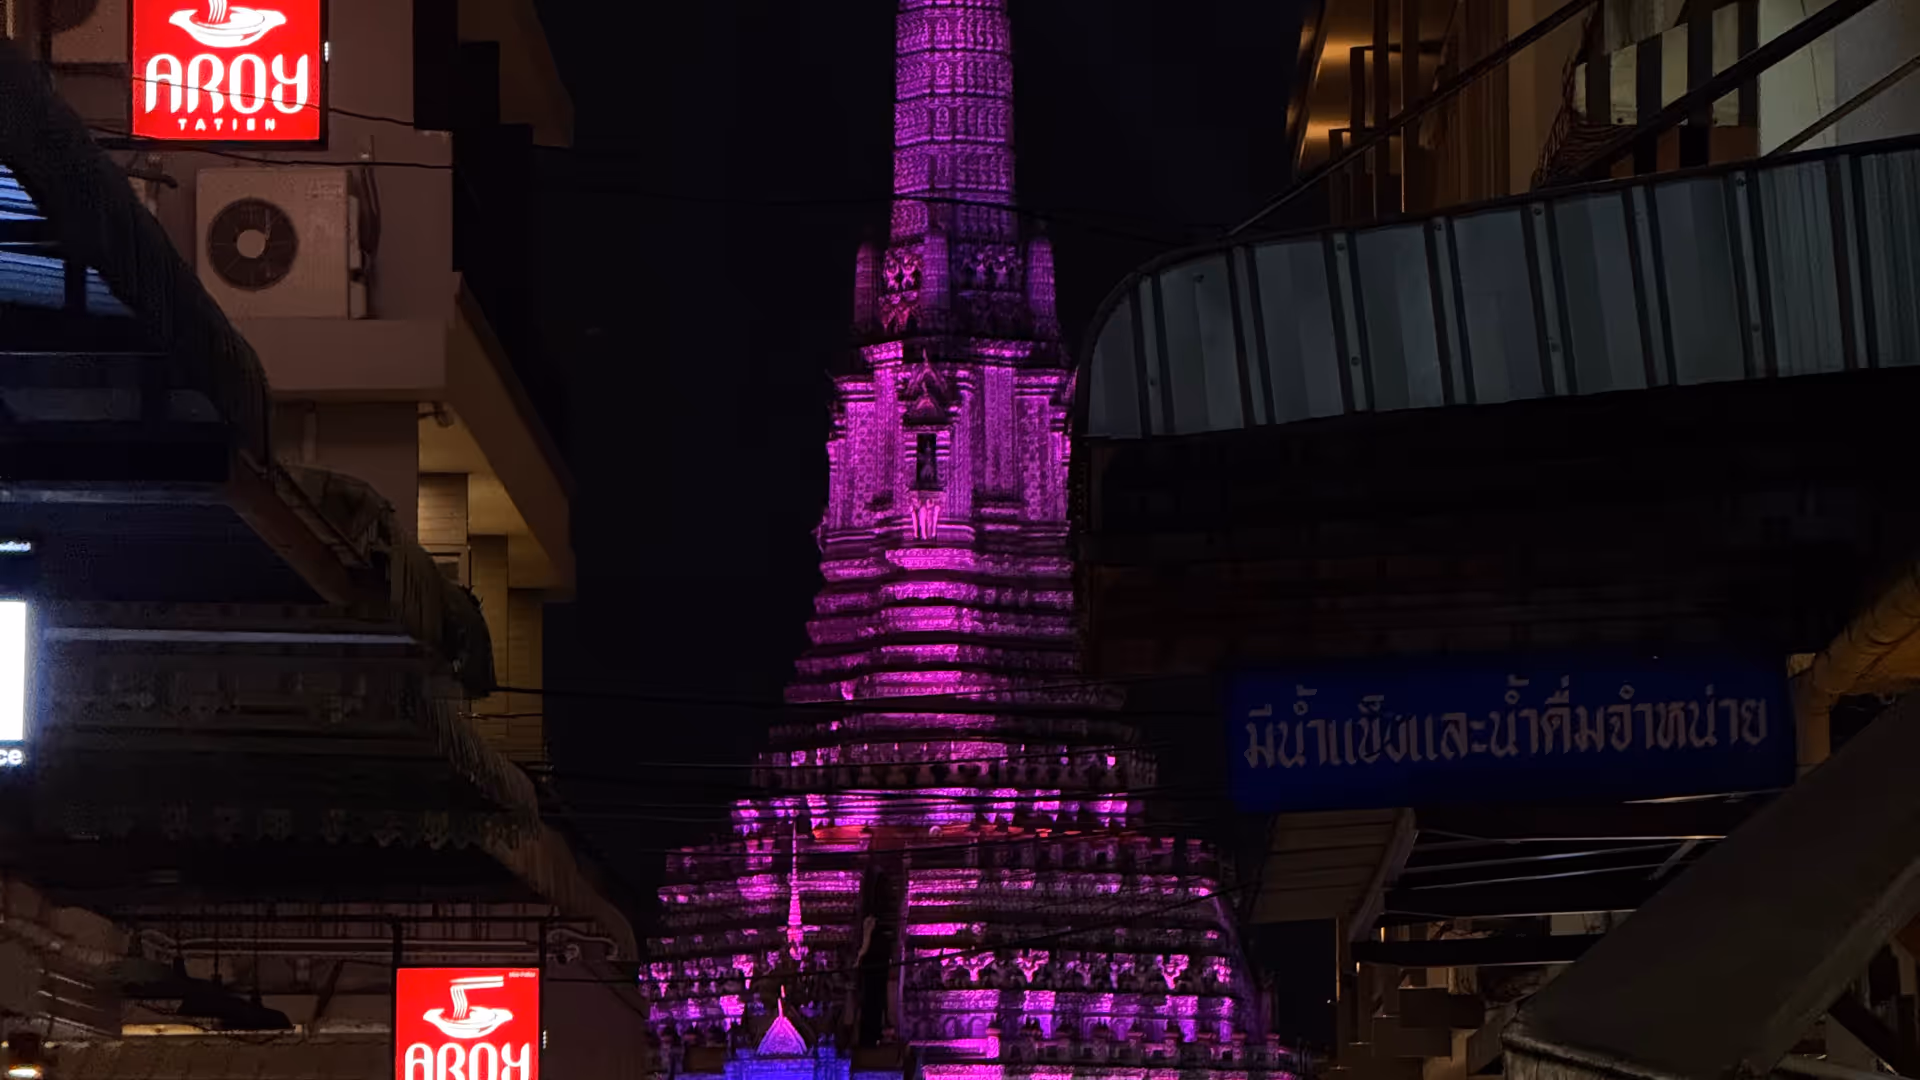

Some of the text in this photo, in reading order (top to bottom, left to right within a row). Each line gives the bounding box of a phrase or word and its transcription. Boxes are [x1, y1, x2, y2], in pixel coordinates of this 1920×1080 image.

[145, 53, 309, 115] AROY
[177, 117, 277, 132] TATIEN
[404, 1042, 530, 1080] AROY
